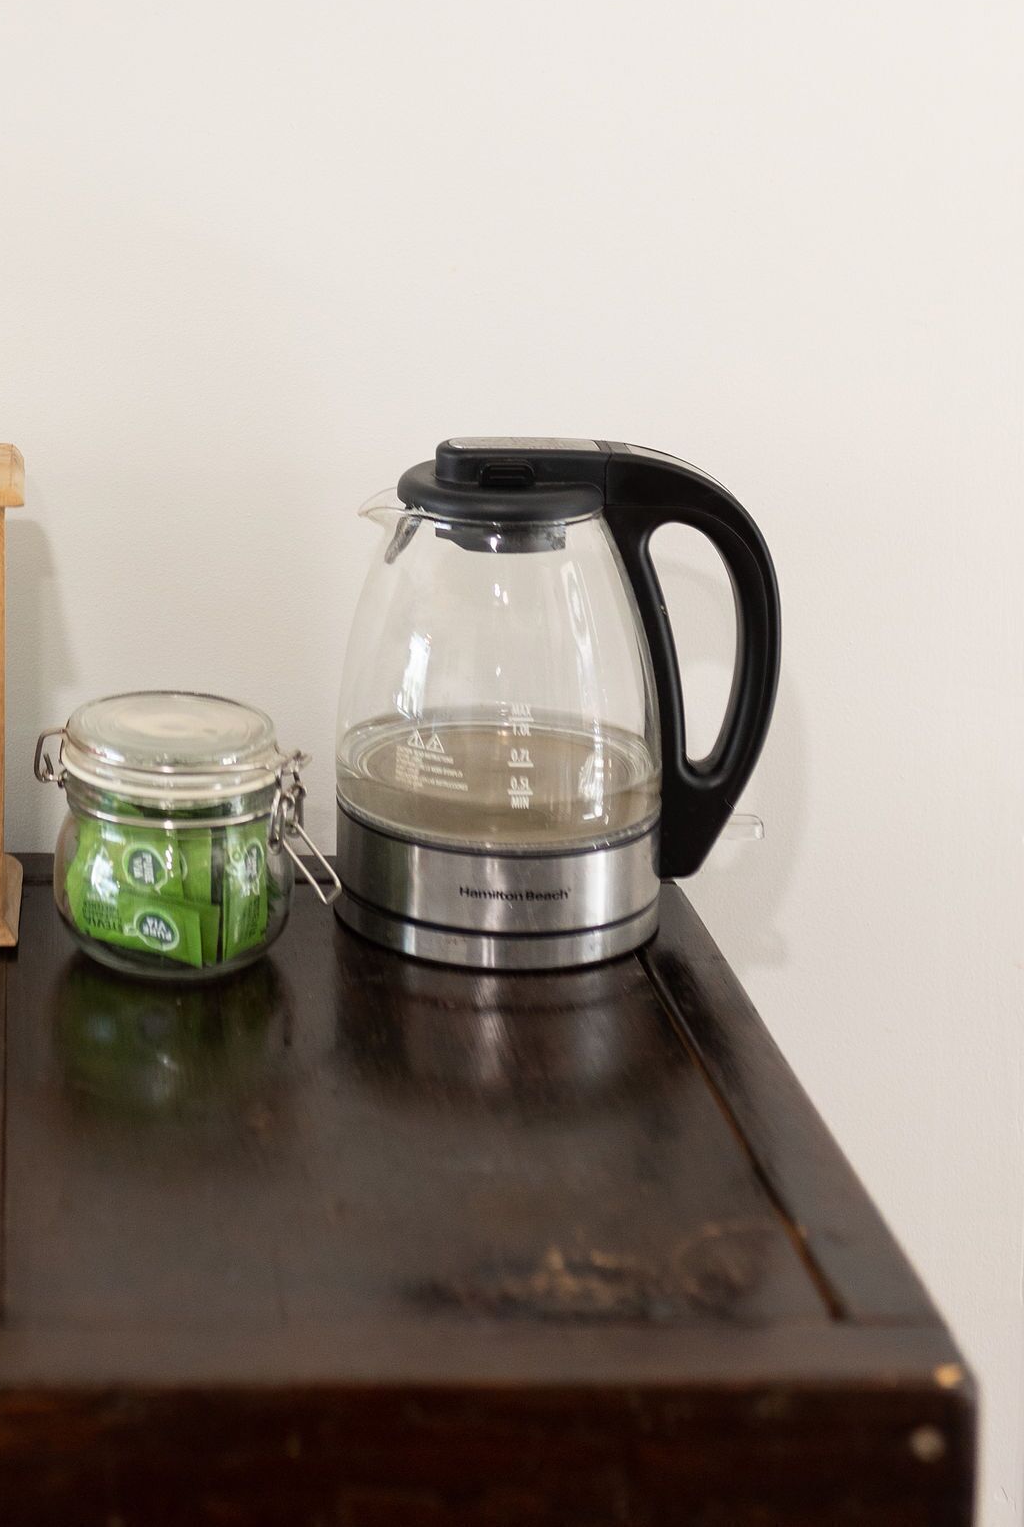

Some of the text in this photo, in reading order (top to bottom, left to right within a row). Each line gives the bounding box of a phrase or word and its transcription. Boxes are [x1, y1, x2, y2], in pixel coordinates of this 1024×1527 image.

[511, 795, 530, 809] MIN
[458, 885, 569, 902] Hamilton Beach
